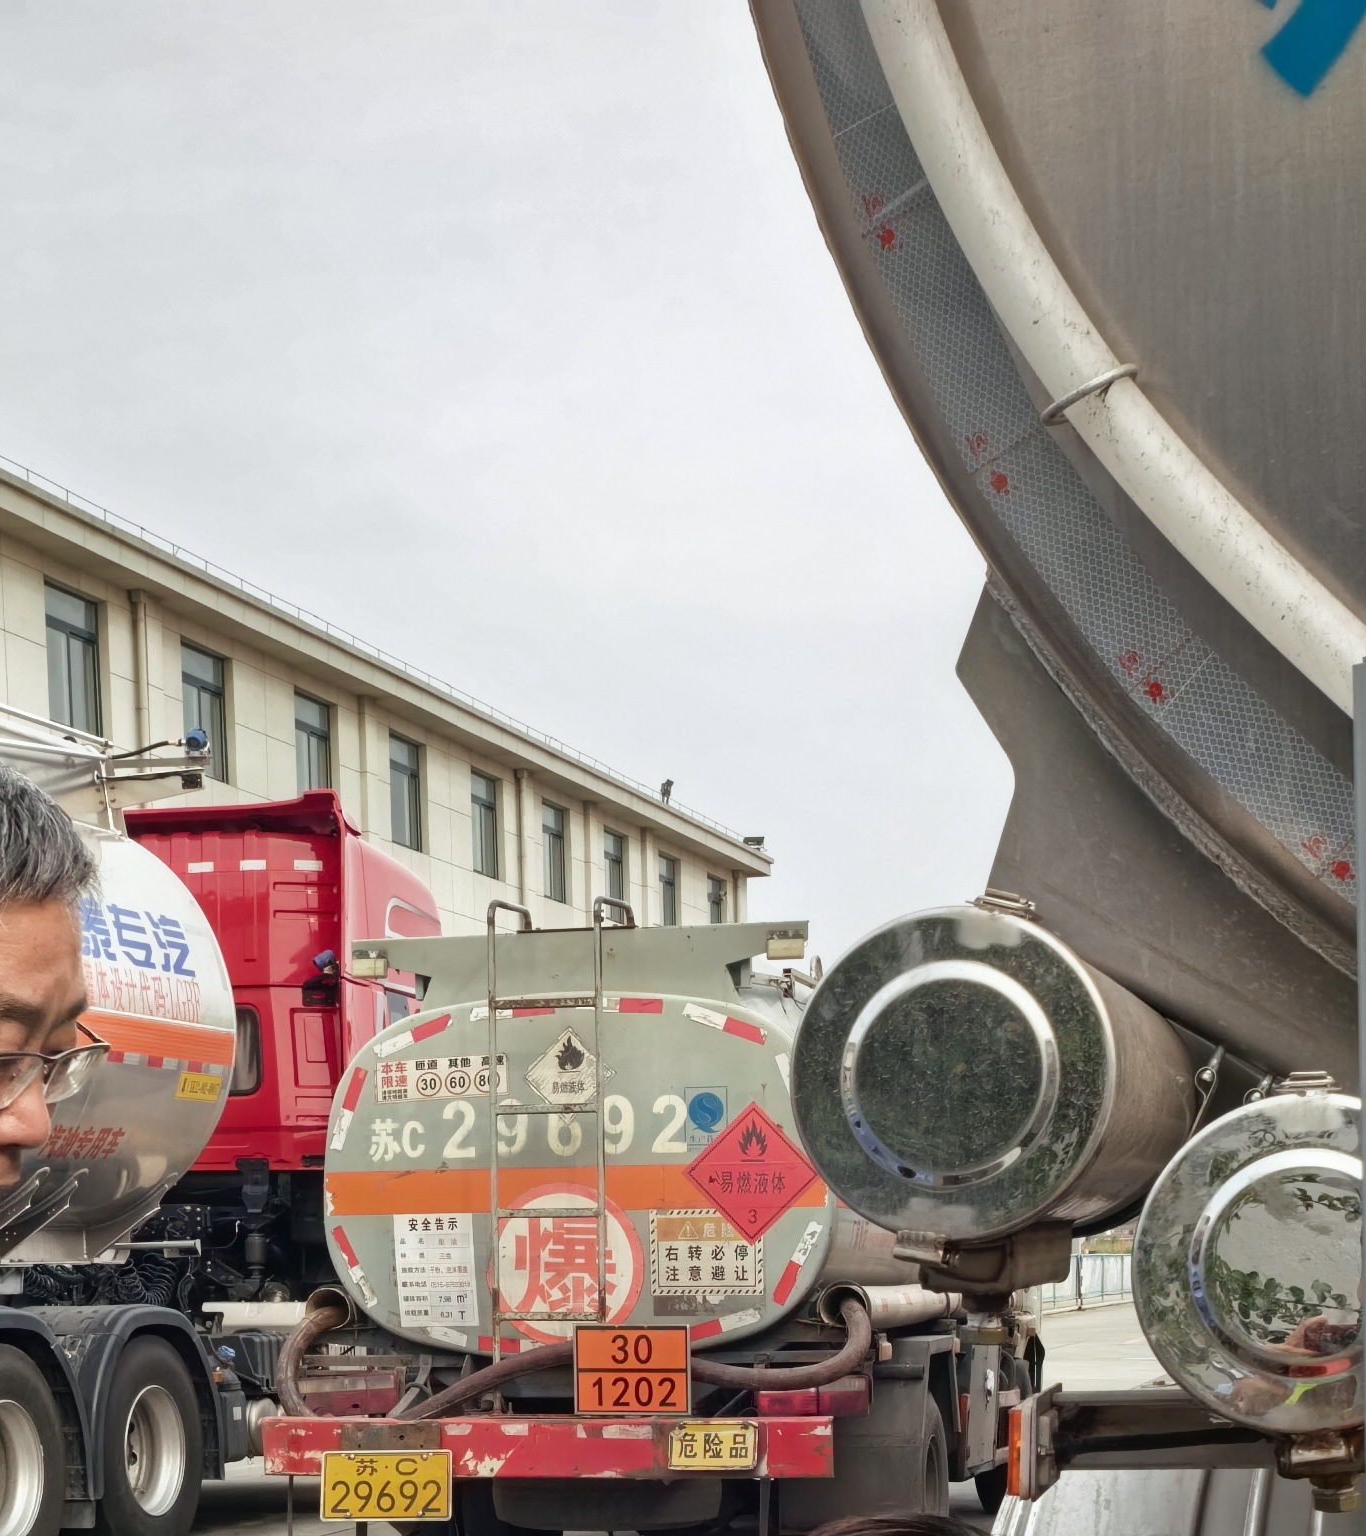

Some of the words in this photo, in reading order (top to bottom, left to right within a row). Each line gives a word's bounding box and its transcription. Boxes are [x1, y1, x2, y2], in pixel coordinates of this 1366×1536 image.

[381, 1062, 407, 1075] 本车
[448, 1058, 471, 1068] 其他
[381, 1075, 408, 1088] 限速
[421, 1078, 437, 1090] 30
[450, 1076, 466, 1088] 60
[720, 1172, 785, 1195] 易燃液体
[408, 1217, 458, 1231] 安全告示
[748, 1209, 757, 1224] 3
[665, 1245, 748, 1262] 右转必停
[515, 1207, 618, 1318] 爆
[665, 1265, 749, 1282] 注意避让
[458, 1310, 466, 1320] T
[610, 1334, 653, 1364] 30
[592, 1376, 677, 1407] 1202
[678, 1432, 749, 1460] 危险品
[331, 1480, 442, 1514] 29692
